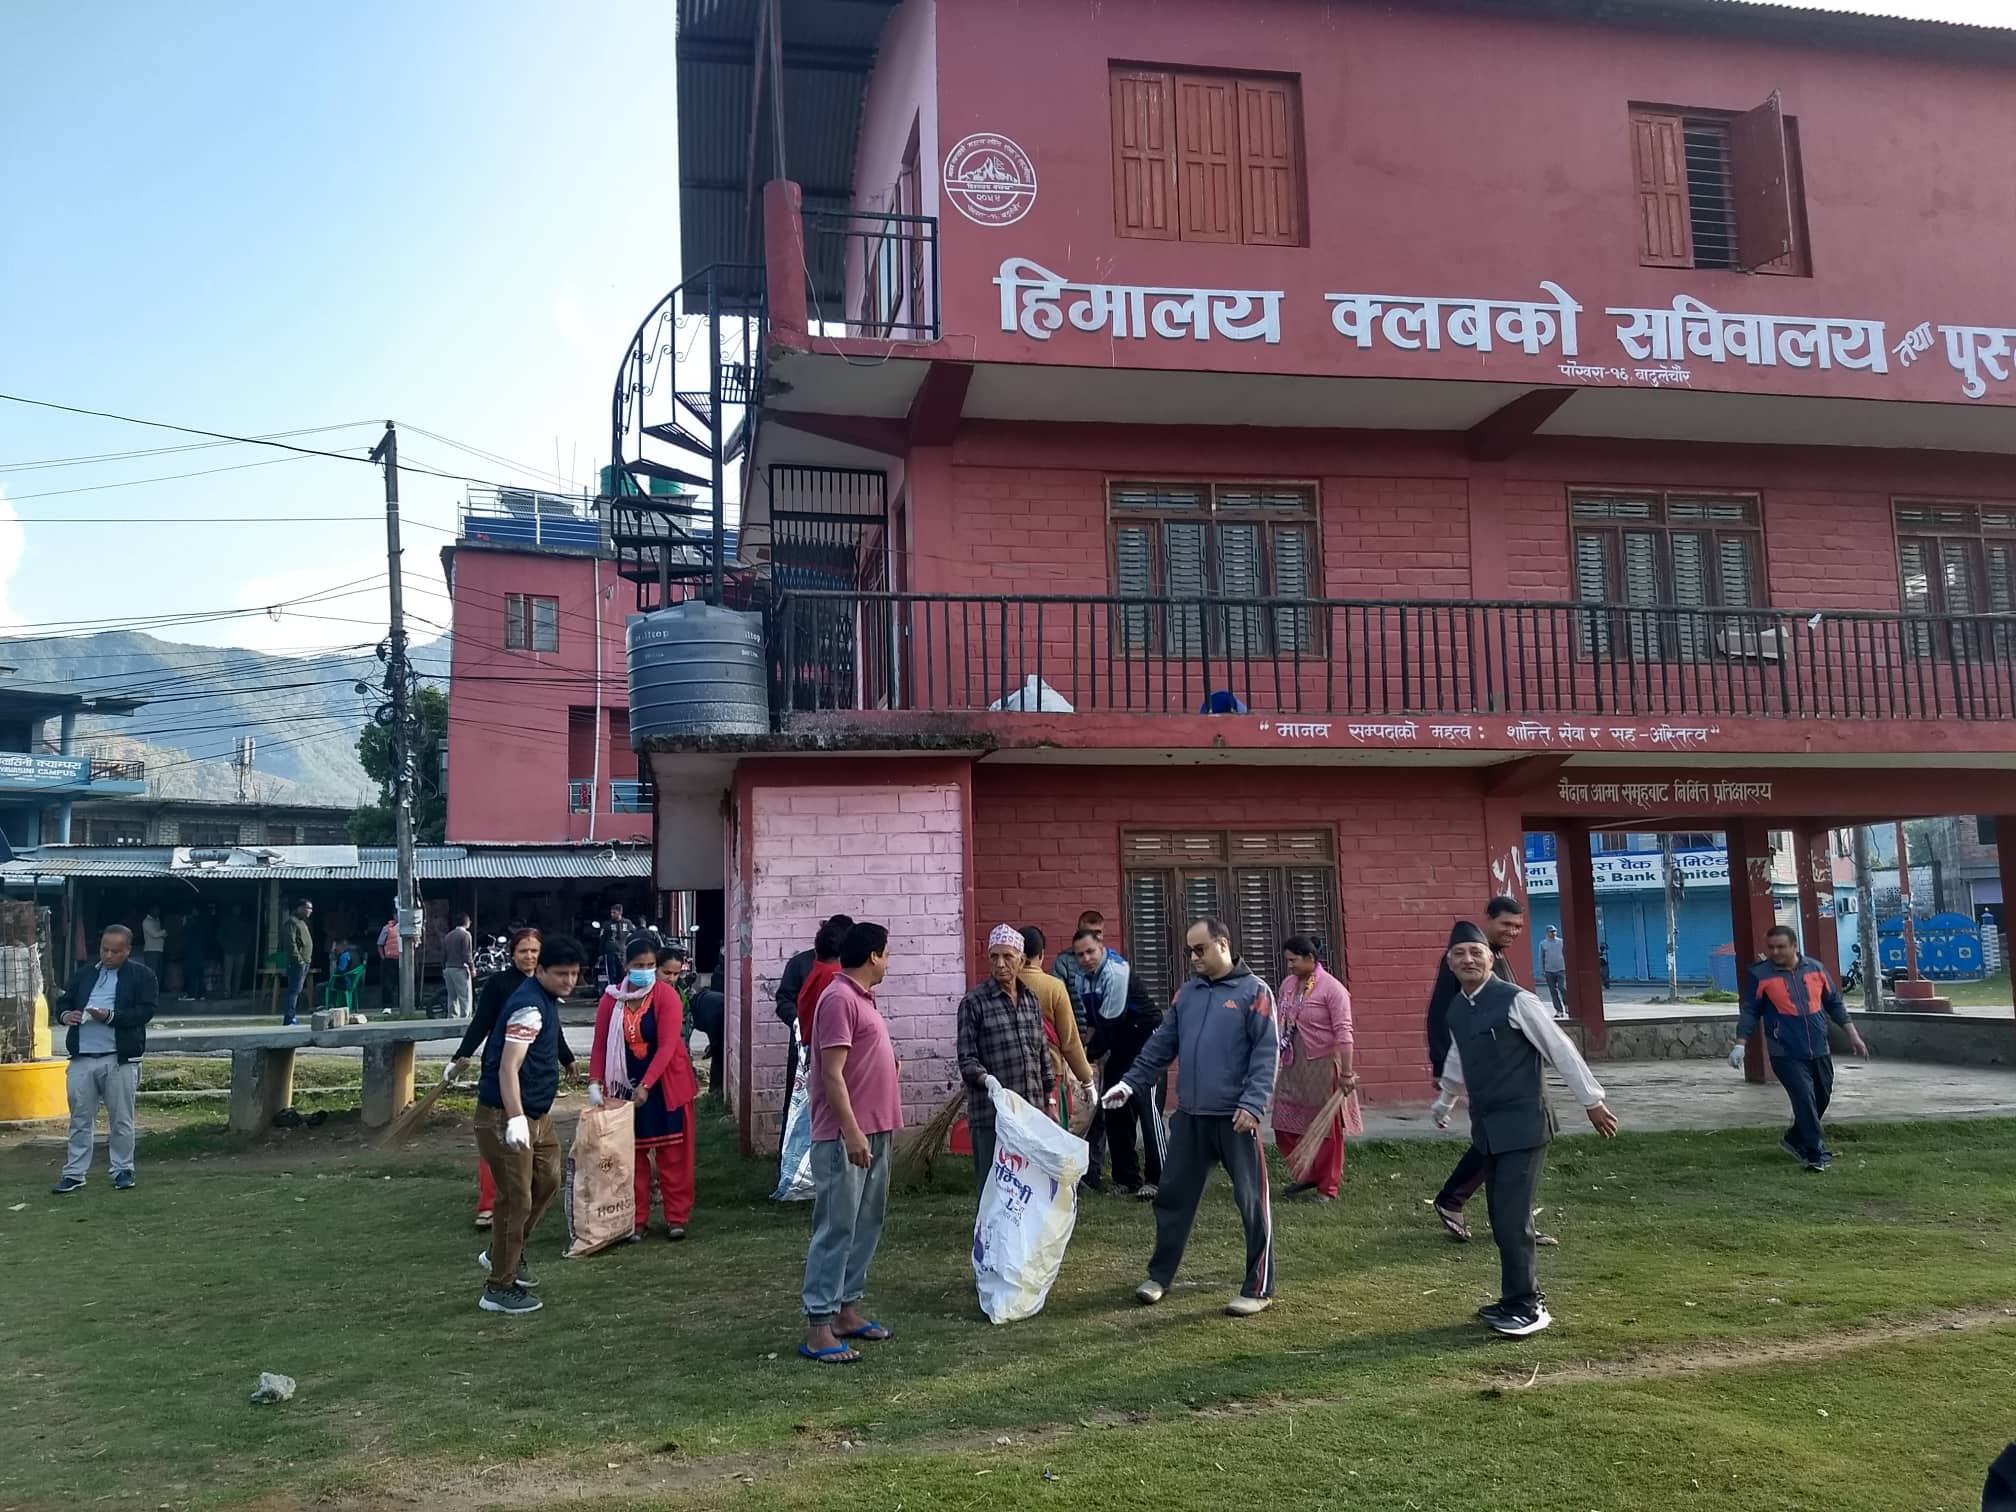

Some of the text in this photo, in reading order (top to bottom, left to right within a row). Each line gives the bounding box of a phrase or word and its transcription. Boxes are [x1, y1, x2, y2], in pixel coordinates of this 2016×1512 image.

[992, 257, 2016, 399] हिमालय क्लबको सचिवालय तथा पुस्
[1347, 720, 1419, 744] सम्पदाको
[1558, 722, 1585, 748] सेवा
[1589, 726, 1602, 748] र
[0, 757, 34, 767] वासिनी
[1557, 776, 1589, 803] मैदान
[1590, 783, 1619, 803] आमा
[1673, 778, 1711, 804] निर्मित
[1612, 871, 1656, 882] Bank
